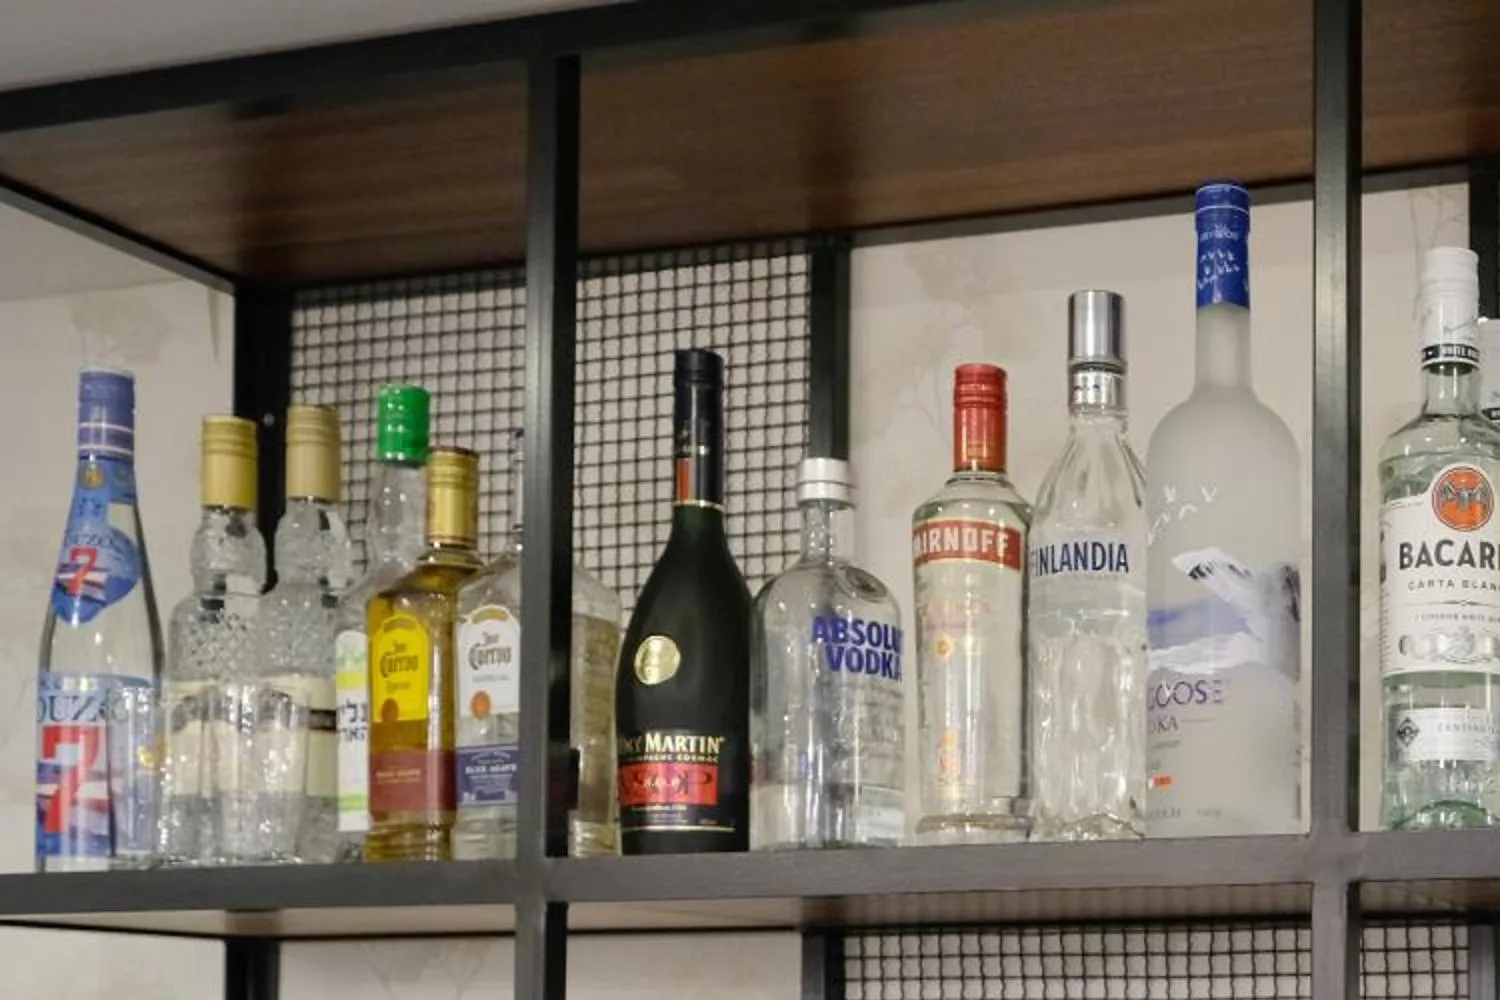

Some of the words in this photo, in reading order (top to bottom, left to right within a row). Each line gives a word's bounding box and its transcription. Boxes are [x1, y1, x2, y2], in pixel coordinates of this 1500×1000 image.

[914, 526, 1009, 557] IRNOFF
[1032, 541, 1130, 577] FINLANDIA
[1408, 579, 1455, 591] CARTA
[812, 616, 904, 652] ABSOLU
[1148, 679, 1224, 711] OOSE
[645, 732, 720, 754] MARTIN
[42, 725, 101, 832] 7
